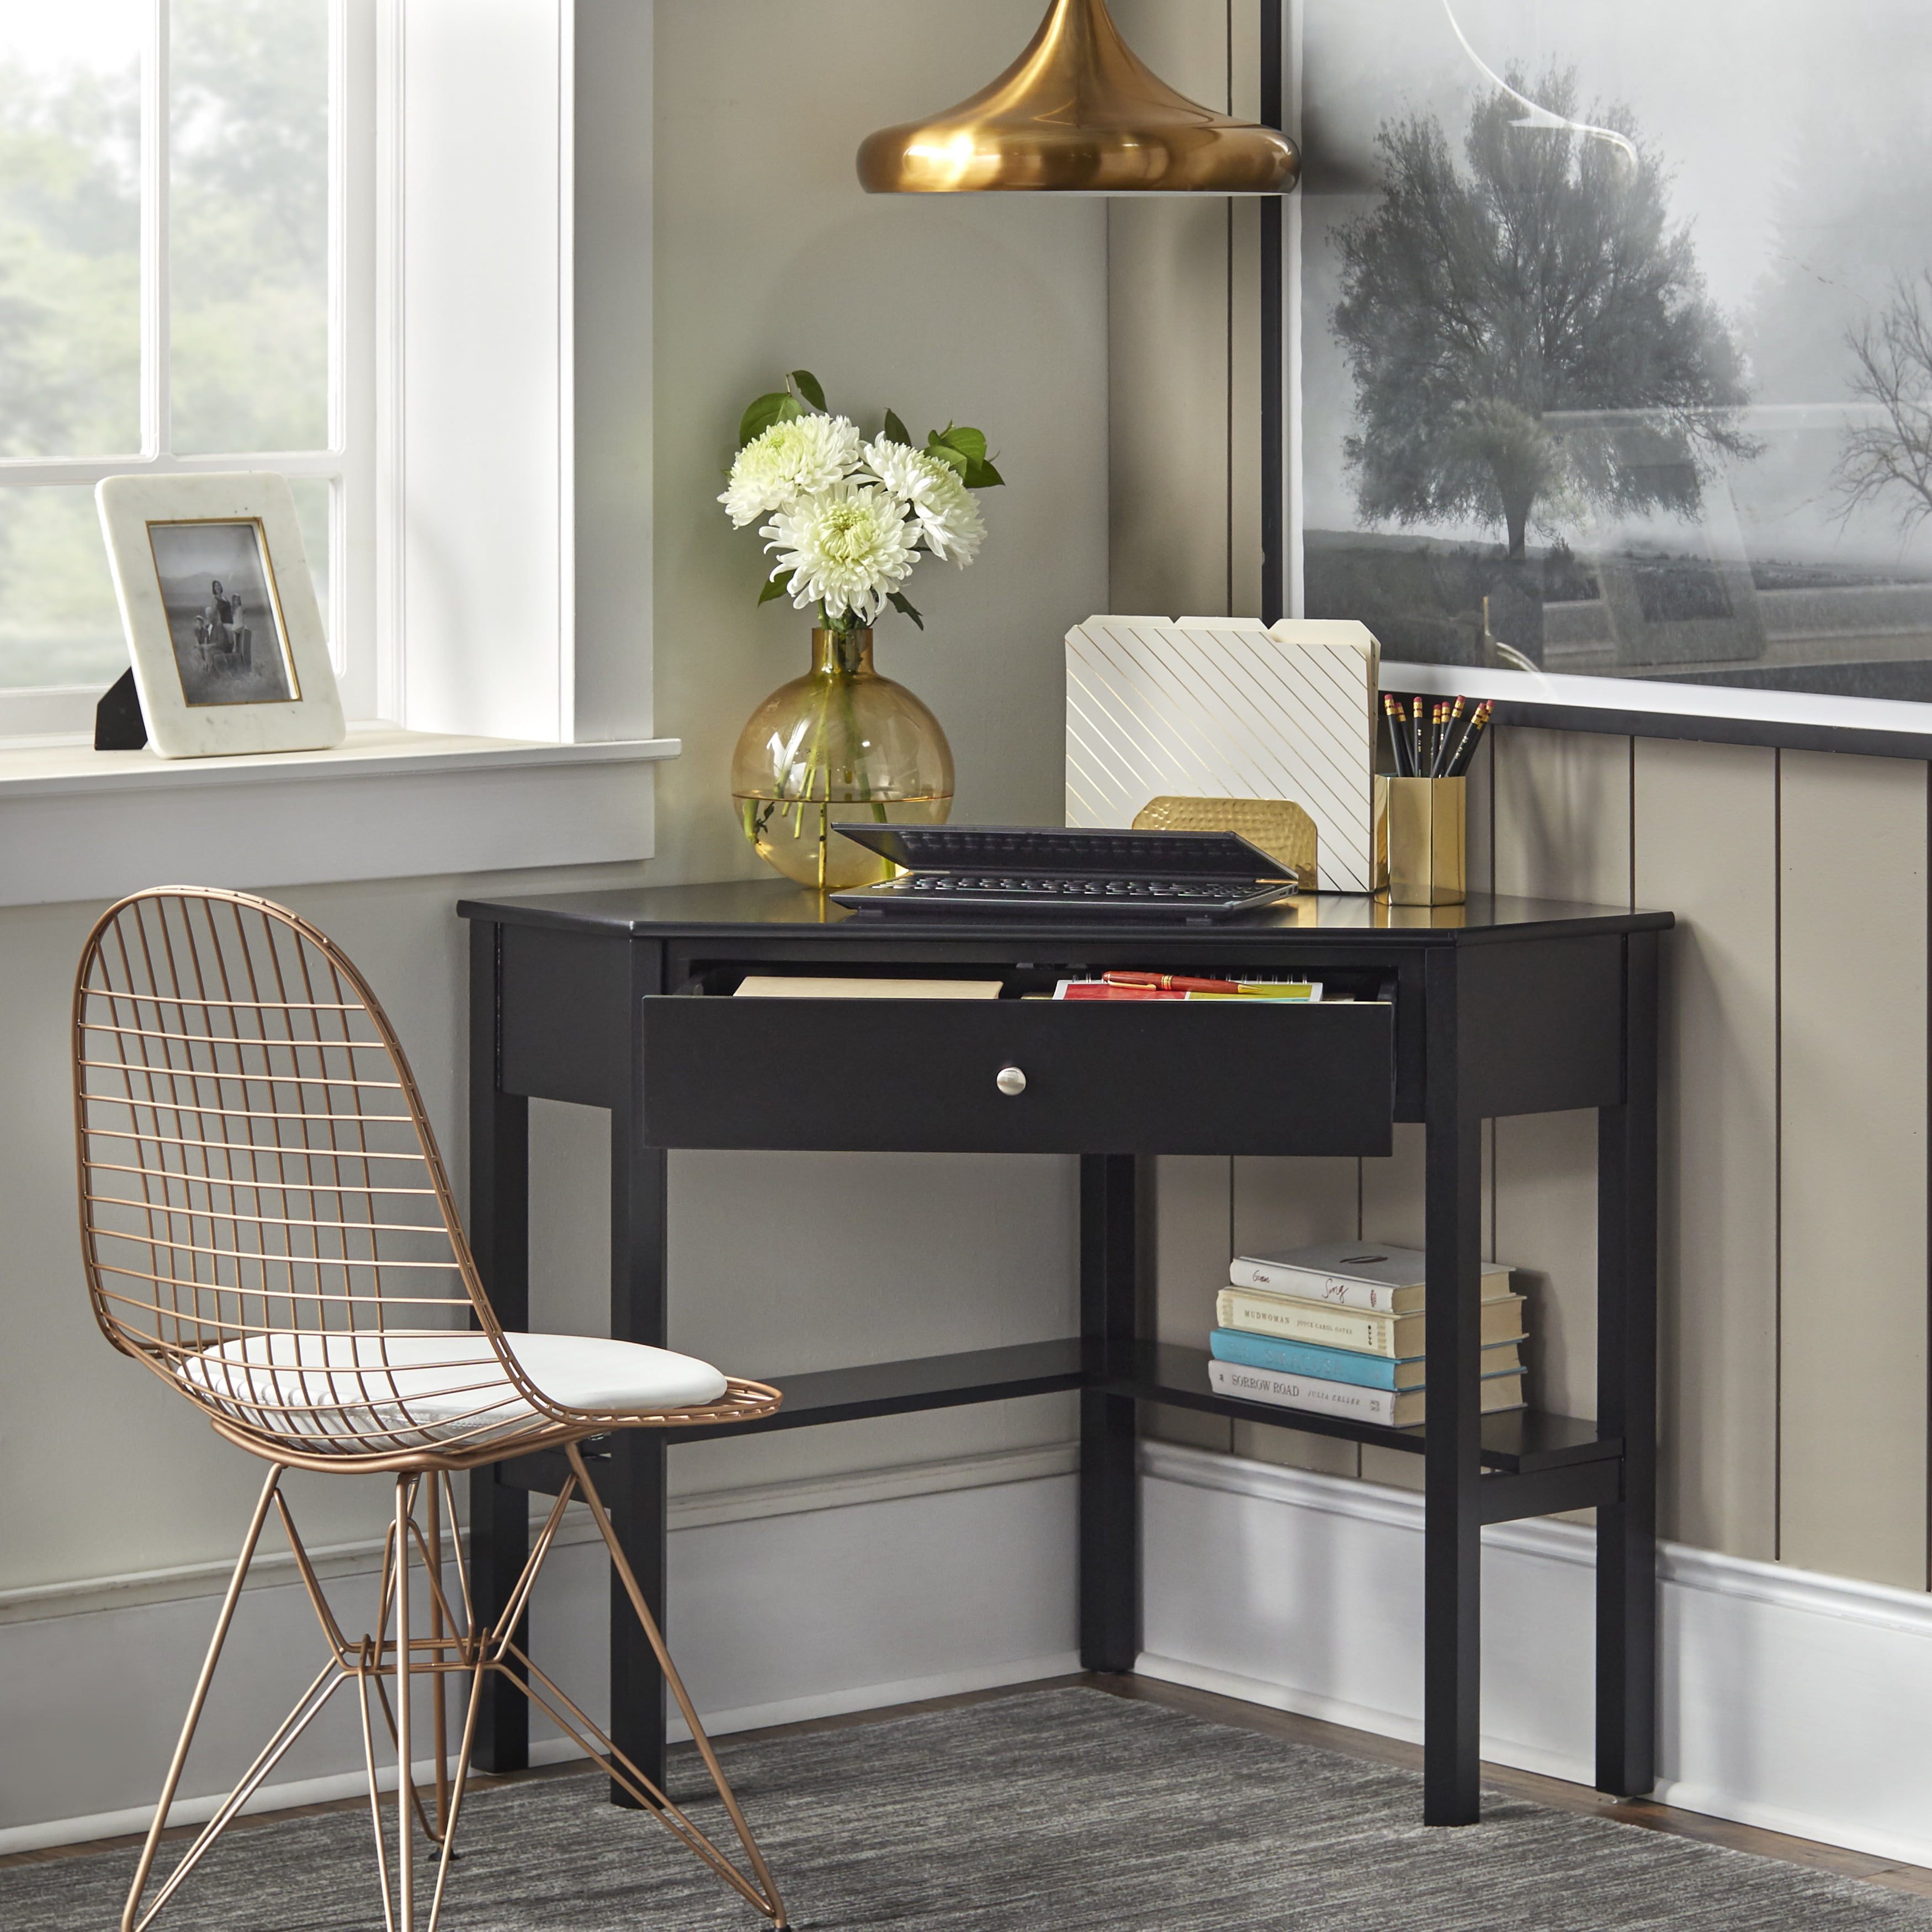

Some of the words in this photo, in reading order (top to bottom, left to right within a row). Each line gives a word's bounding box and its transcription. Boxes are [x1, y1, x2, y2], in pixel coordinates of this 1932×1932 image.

[1244, 1310, 1289, 1324] MUDWOMAN
[1232, 1374, 1270, 1390] SORROW
[1273, 1382, 1299, 1397] ROAD
[1308, 1390, 1329, 1400] JULIA
